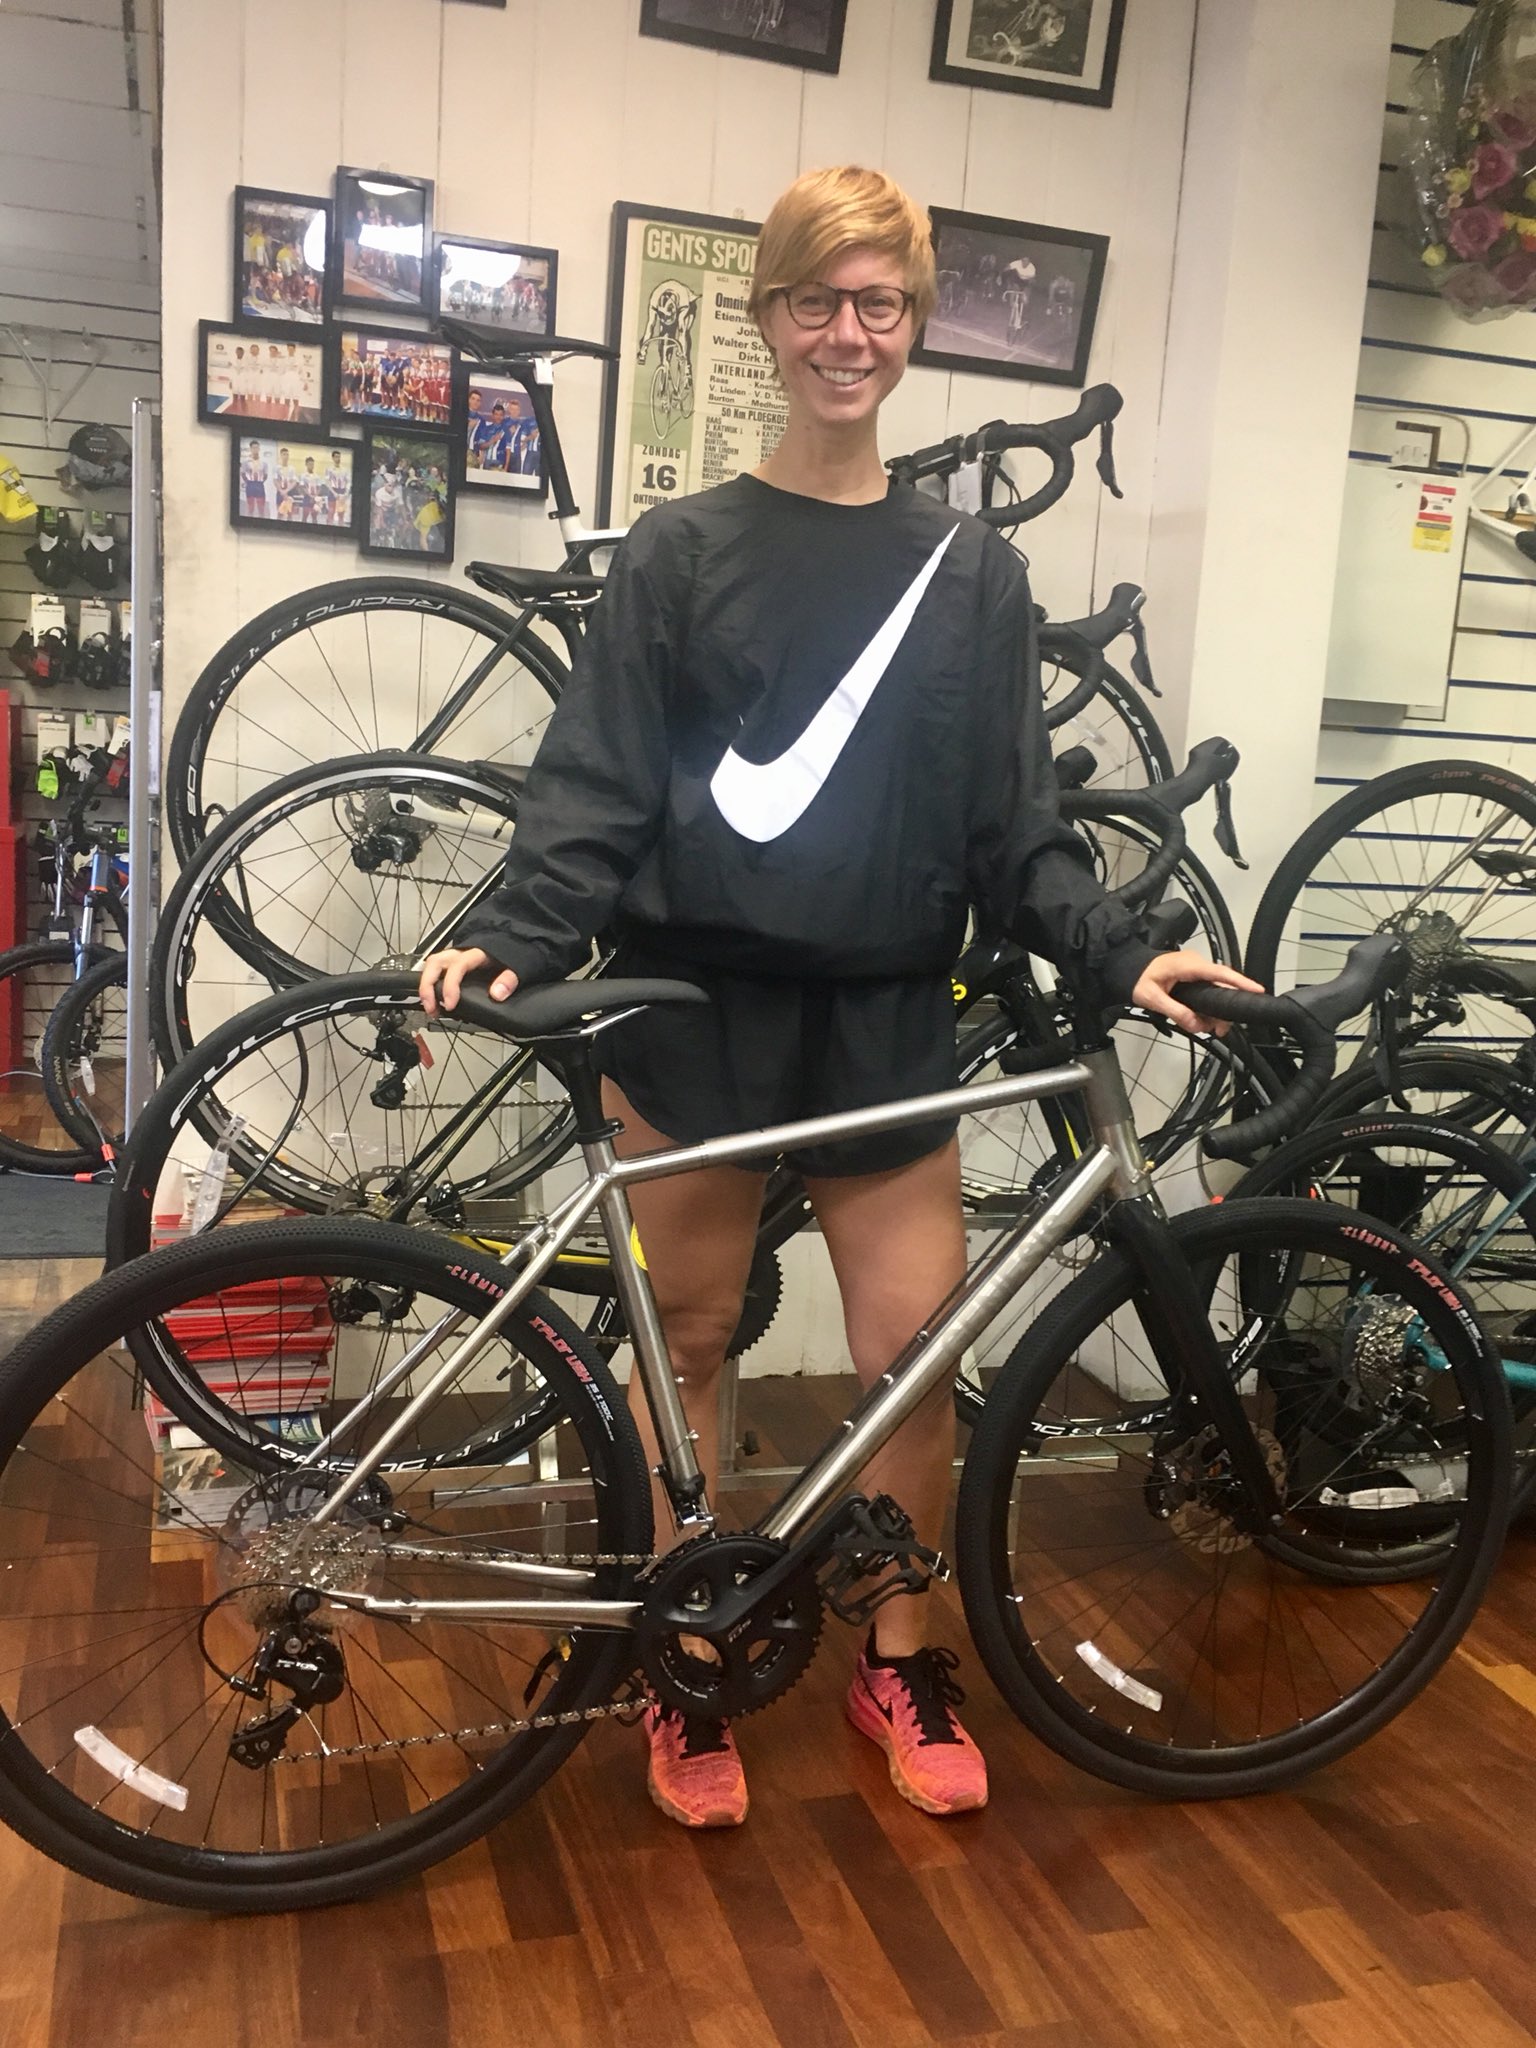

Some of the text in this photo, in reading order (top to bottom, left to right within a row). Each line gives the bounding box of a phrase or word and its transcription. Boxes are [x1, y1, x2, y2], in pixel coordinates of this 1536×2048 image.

[647, 228, 708, 265] GENTS
[715, 292, 748, 311] Omni
[714, 311, 753, 325] Etienn
[712, 336, 748, 350] Walter
[738, 352, 761, 364] Dirk
[713, 364, 766, 381] INTERLAND
[720, 387, 746, 396] Linden
[708, 394, 789, 411] Burton Medhurst
[721, 407, 731, 418] 50
[733, 409, 746, 420] Km
[642, 444, 681, 459] ZONDAG
[641, 463, 677, 491] 16
